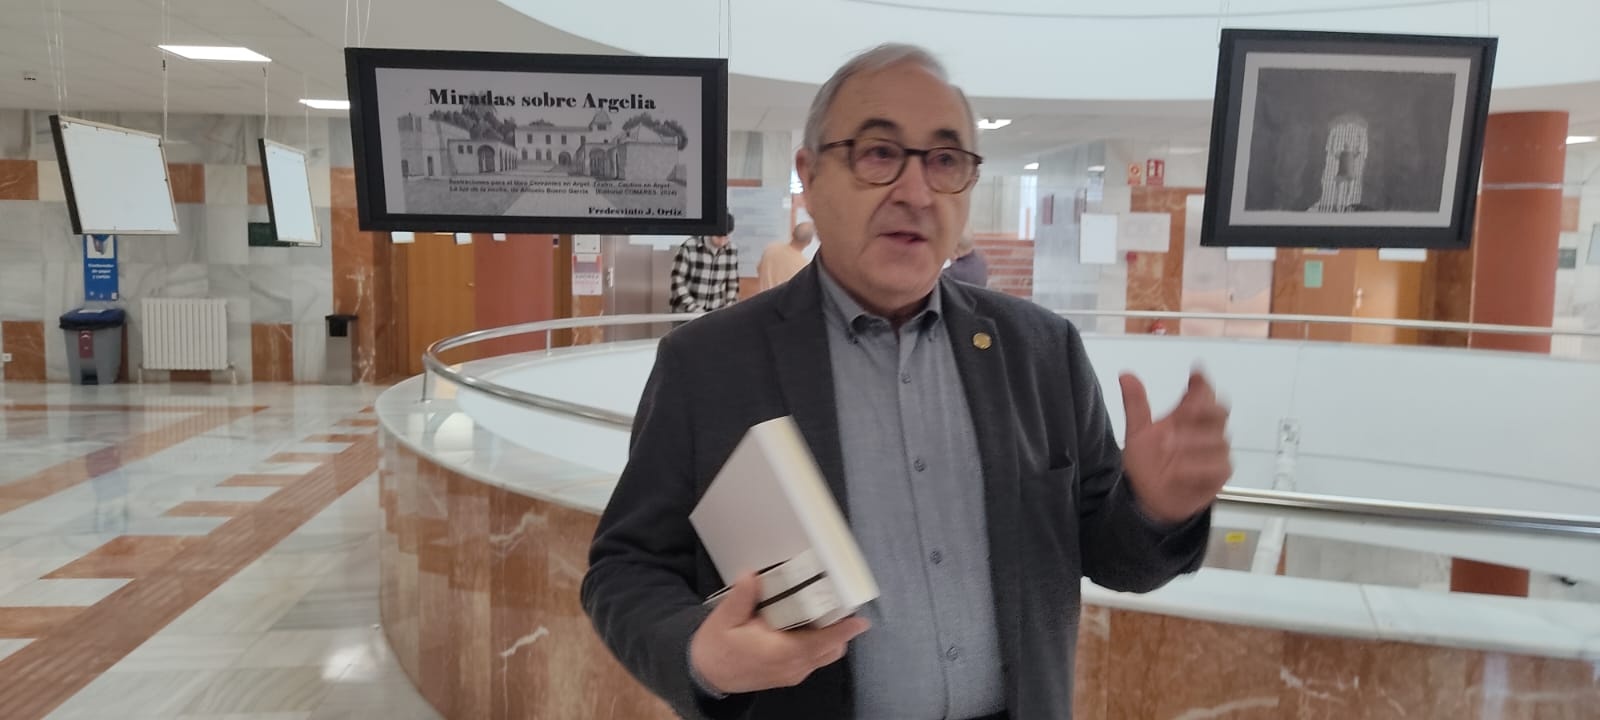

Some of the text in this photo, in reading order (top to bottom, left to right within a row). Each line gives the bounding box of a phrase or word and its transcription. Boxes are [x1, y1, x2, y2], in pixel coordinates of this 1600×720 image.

[429, 89, 656, 113] Miradas sobre Argelia
[657, 208, 682, 216] Ortiz
